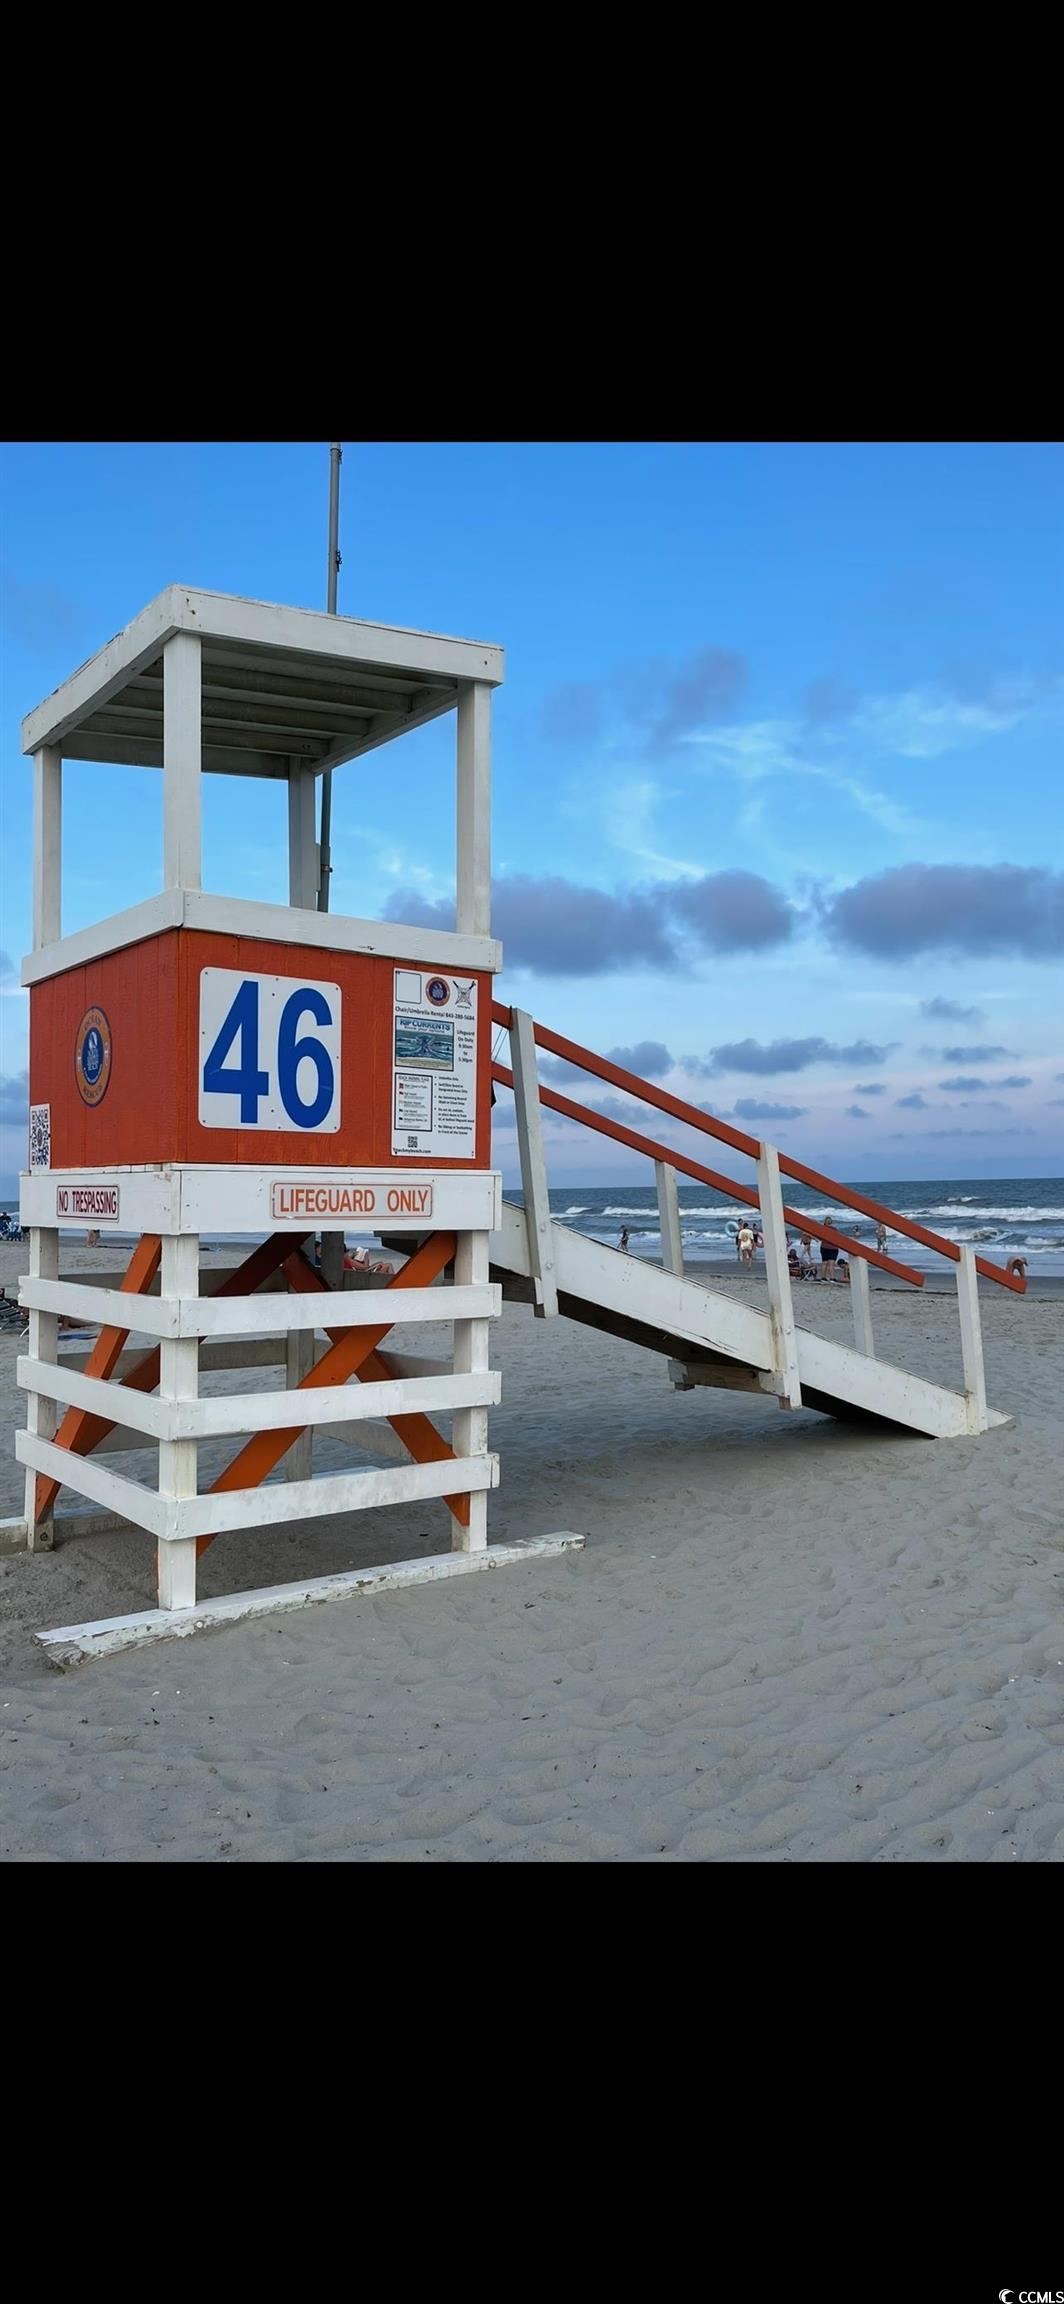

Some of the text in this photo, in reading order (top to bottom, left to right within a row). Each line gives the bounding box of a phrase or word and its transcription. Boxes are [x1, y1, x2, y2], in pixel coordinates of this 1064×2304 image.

[412, 1020, 451, 1031] CURRENTS
[203, 980, 334, 1129] 46
[59, 1191, 116, 1214] NO TRESPASSING
[280, 1188, 428, 1212] LIFEGUARD ONLY
